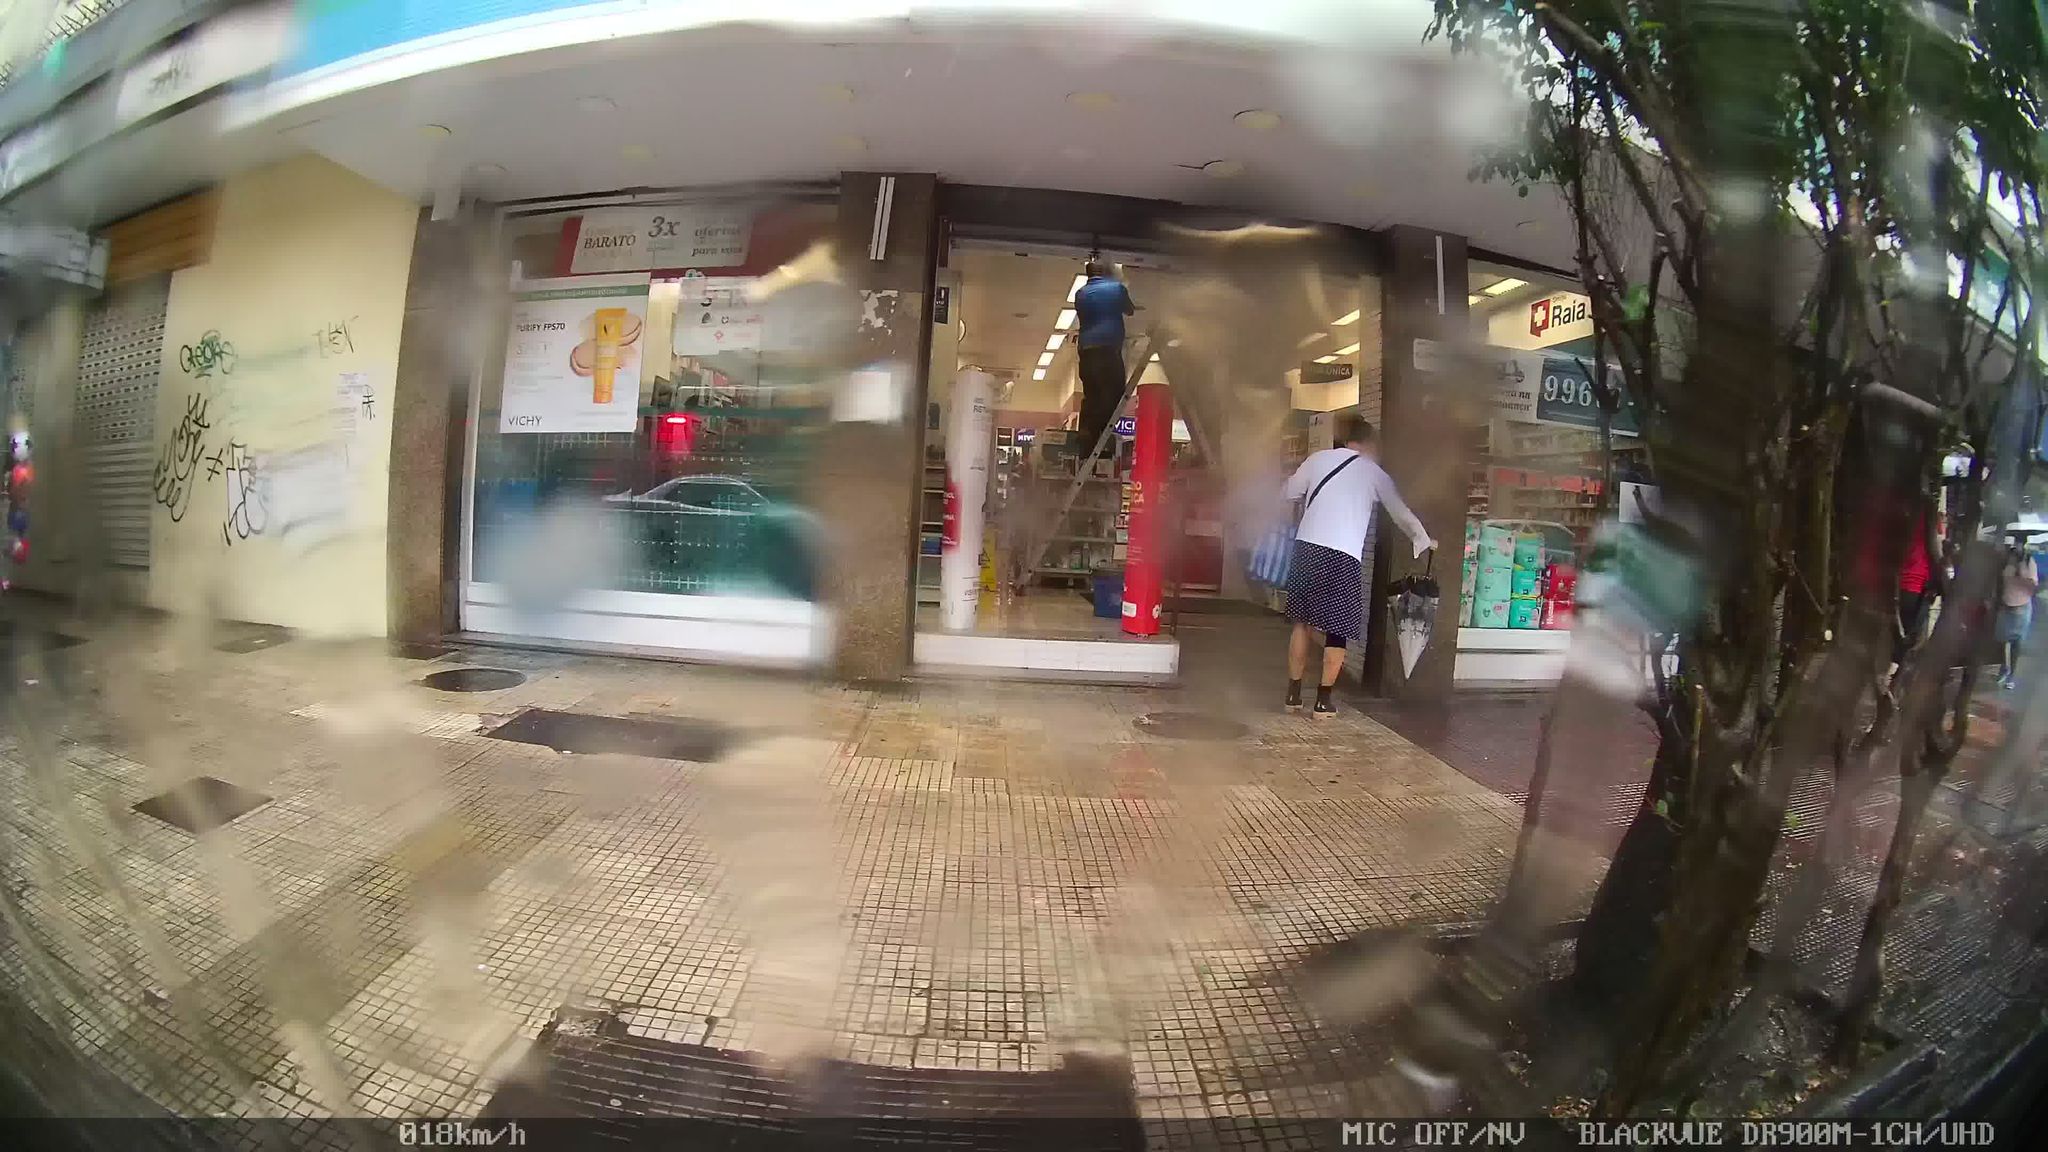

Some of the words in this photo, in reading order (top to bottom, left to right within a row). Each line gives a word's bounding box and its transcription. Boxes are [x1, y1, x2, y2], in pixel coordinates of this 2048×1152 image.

[648, 216, 680, 237] 3x
[584, 235, 637, 249] BARATO
[1551, 300, 1586, 328] Raia
[543, 322, 566, 331] FPS70
[1543, 375, 1600, 408] 996
[508, 415, 542, 427] VICHY
[1114, 420, 1136, 430] VIC
